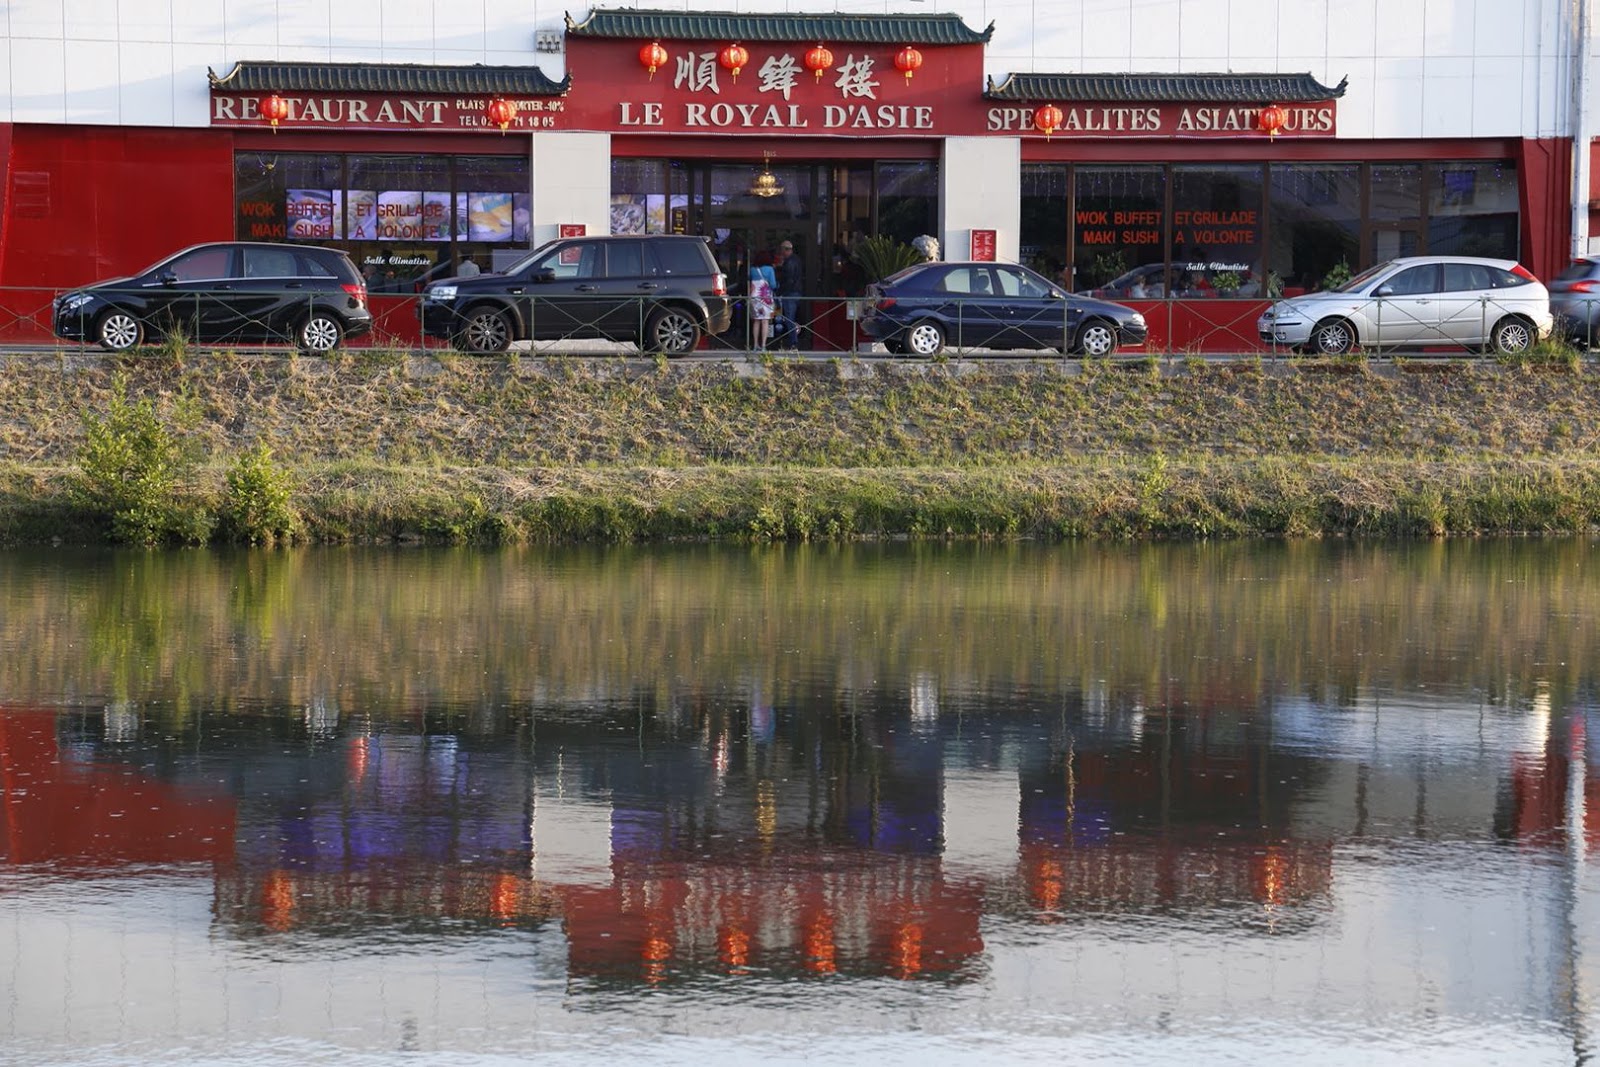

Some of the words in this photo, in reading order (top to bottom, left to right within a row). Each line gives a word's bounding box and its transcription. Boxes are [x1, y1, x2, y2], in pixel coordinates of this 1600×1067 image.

[213, 97, 448, 124] RETAURANT
[456, 99, 485, 110] PLATS
[459, 116, 478, 127] TEL
[528, 117, 539, 127] 18
[542, 117, 555, 128] 05
[619, 102, 664, 126] LE
[685, 103, 808, 128] ROYAL
[823, 105, 934, 130] D'ASIE
[987, 107, 1161, 132] SPEALITES
[240, 203, 274, 217] WOK
[285, 203, 337, 217] BUFFET
[357, 204, 371, 217] ET
[376, 204, 443, 218] GRILLADE
[1076, 211, 1108, 225] WOK
[1114, 211, 1162, 225] BUFFET
[1175, 211, 1191, 225] ET
[1193, 211, 1257, 225] GRILLADE
[251, 224, 286, 238] MAKI
[295, 225, 335, 238] SUSHI
[355, 226, 365, 238] A
[375, 225, 438, 238] VOLONTE
[1083, 230, 1116, 244] MAKI
[1122, 230, 1160, 244] SUSHI
[1175, 231, 1185, 244] A
[1194, 230, 1254, 244] VOLONTE
[364, 256, 386, 265] Salle
[1186, 262, 1207, 271] Salle
